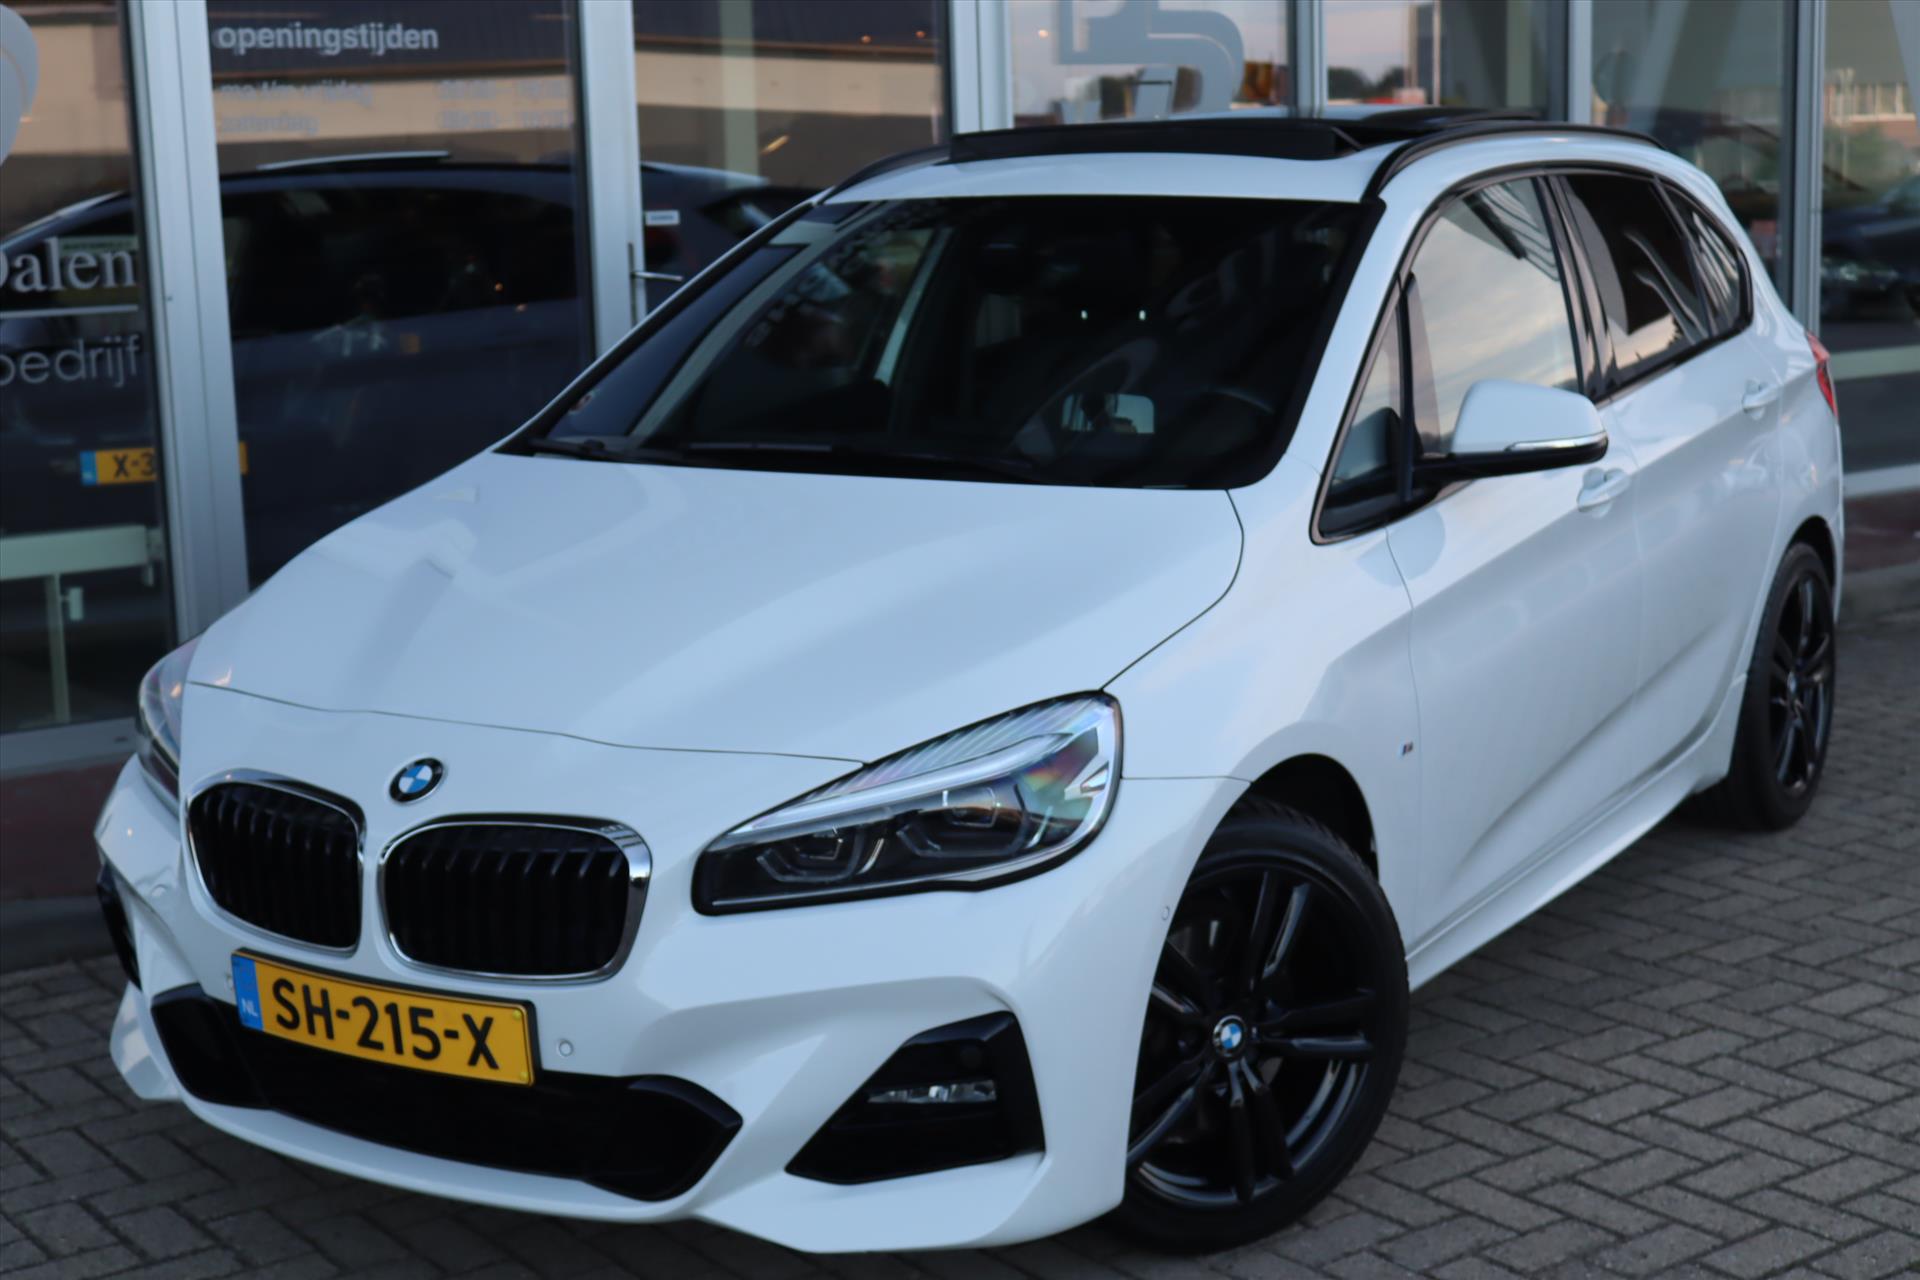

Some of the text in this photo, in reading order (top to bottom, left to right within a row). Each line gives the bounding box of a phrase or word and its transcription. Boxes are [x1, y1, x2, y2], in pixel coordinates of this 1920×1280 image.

[217, 22, 439, 56] openingstijden
[241, 998, 258, 1017] NL
[272, 978, 500, 1070] SH-215-X
